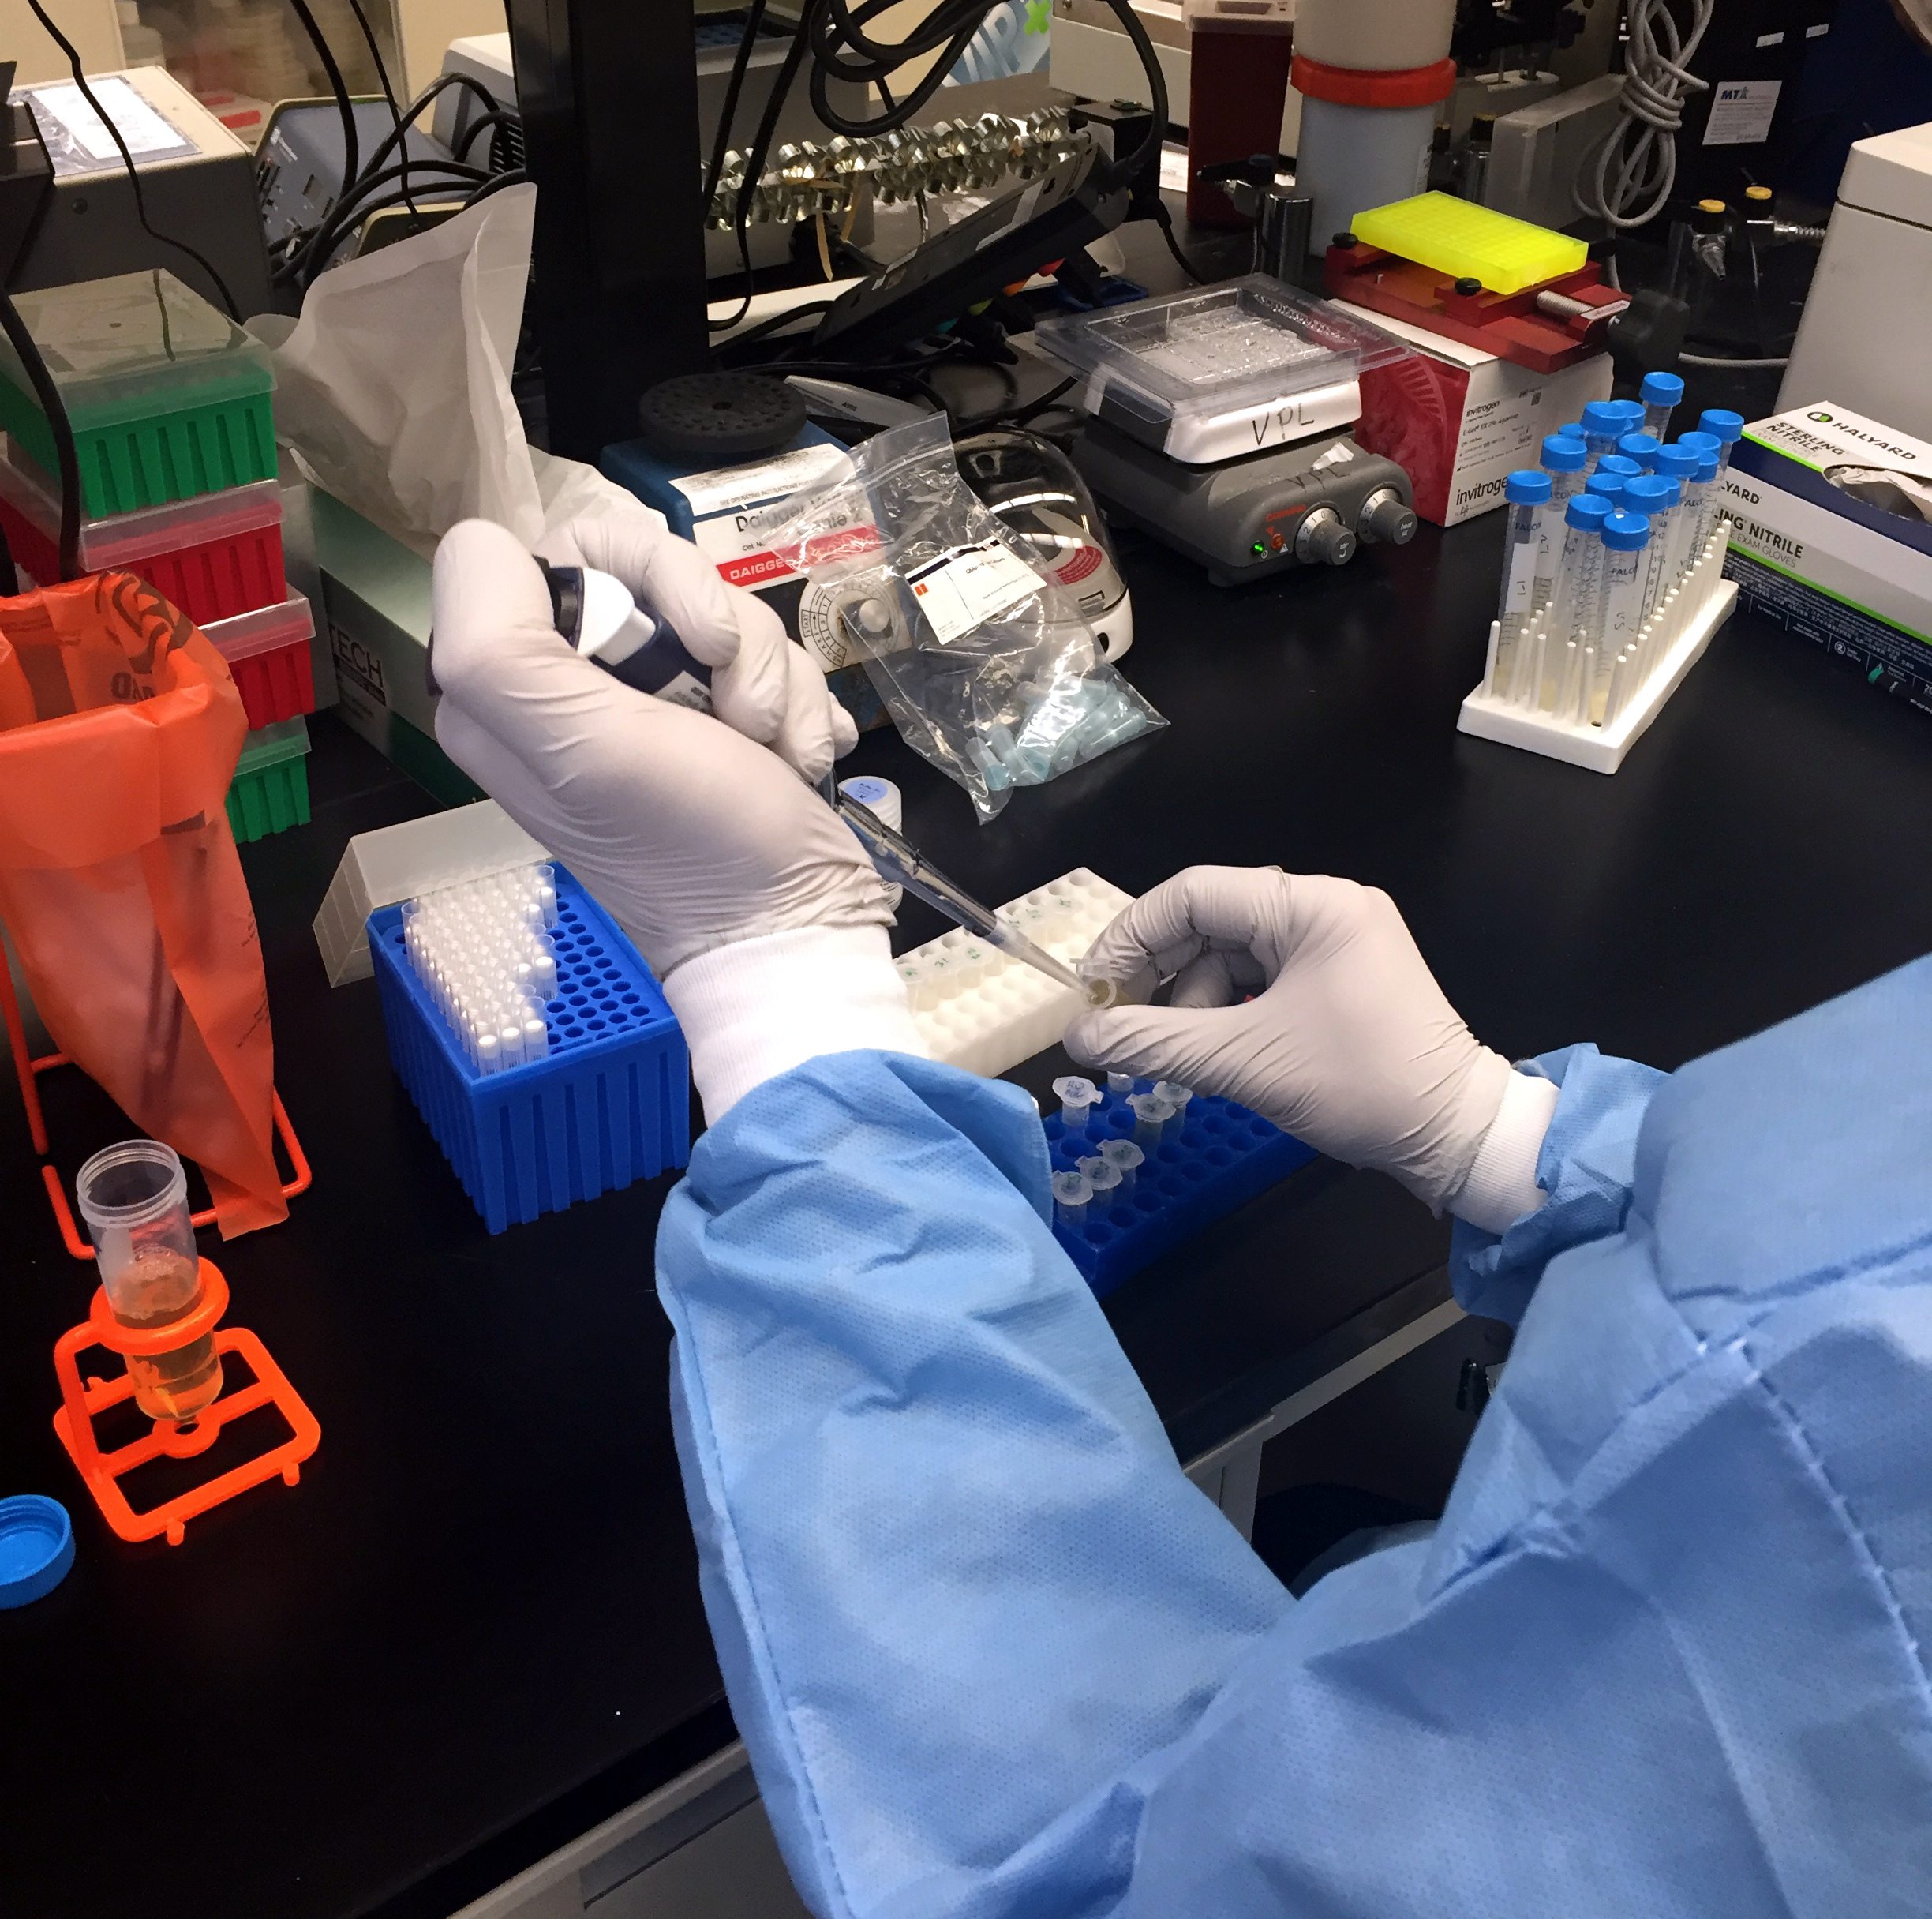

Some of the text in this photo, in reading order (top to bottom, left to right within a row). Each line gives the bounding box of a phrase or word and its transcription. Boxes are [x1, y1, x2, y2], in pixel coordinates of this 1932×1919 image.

[1252, 402, 1314, 446] VPL
[1466, 400, 1500, 418] invitrogen
[1766, 424, 1822, 452] NITRILE
[1777, 421, 1844, 455] STERLING
[1833, 422, 1917, 460] HALYARD
[1455, 476, 1507, 506] invitroge
[1737, 533, 1760, 550] EXAM
[1762, 545, 1796, 568] GLOVES
[1749, 523, 1803, 559] NITRILE
[729, 557, 788, 581] DAIGGE
